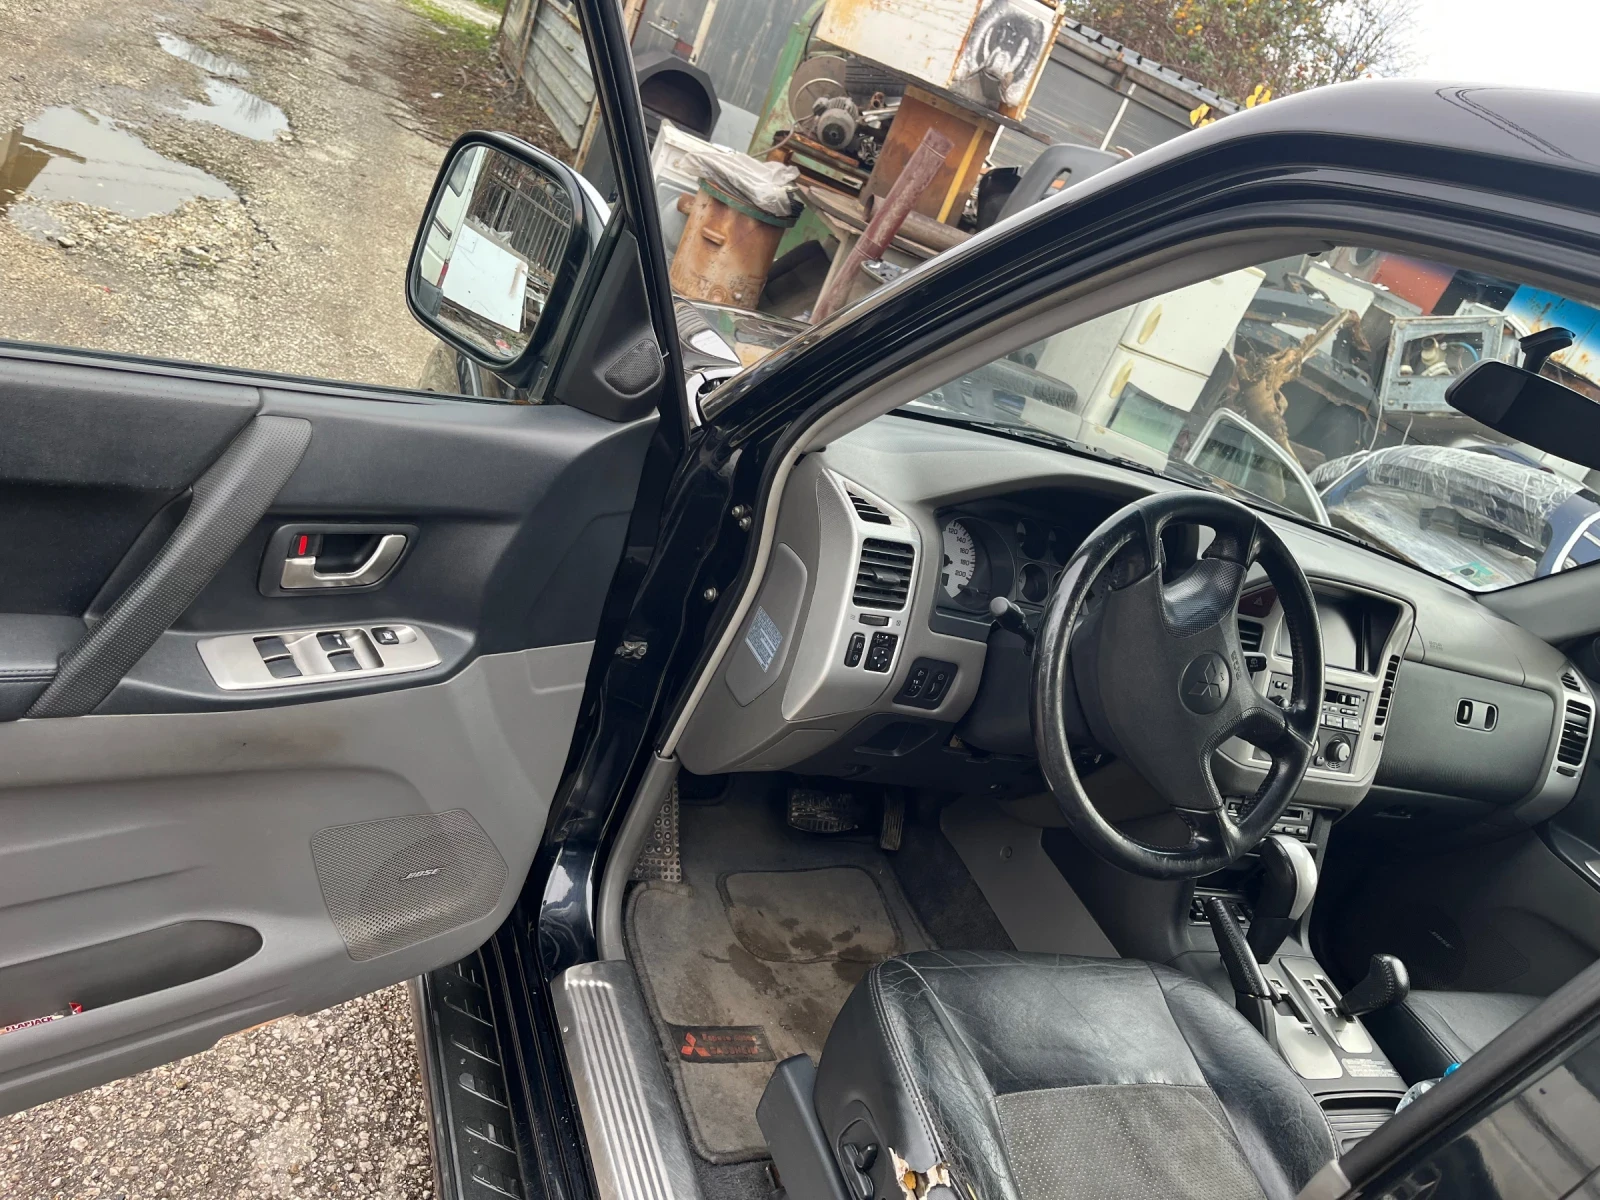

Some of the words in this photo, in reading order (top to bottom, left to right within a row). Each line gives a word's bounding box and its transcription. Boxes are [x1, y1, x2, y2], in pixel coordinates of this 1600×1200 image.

[948, 527, 958, 535] 120
[956, 536, 967, 544] 140
[954, 569, 967, 578] 200
[400, 867, 445, 880] BOSE
[5, 1016, 54, 1032] FLAPJACK
